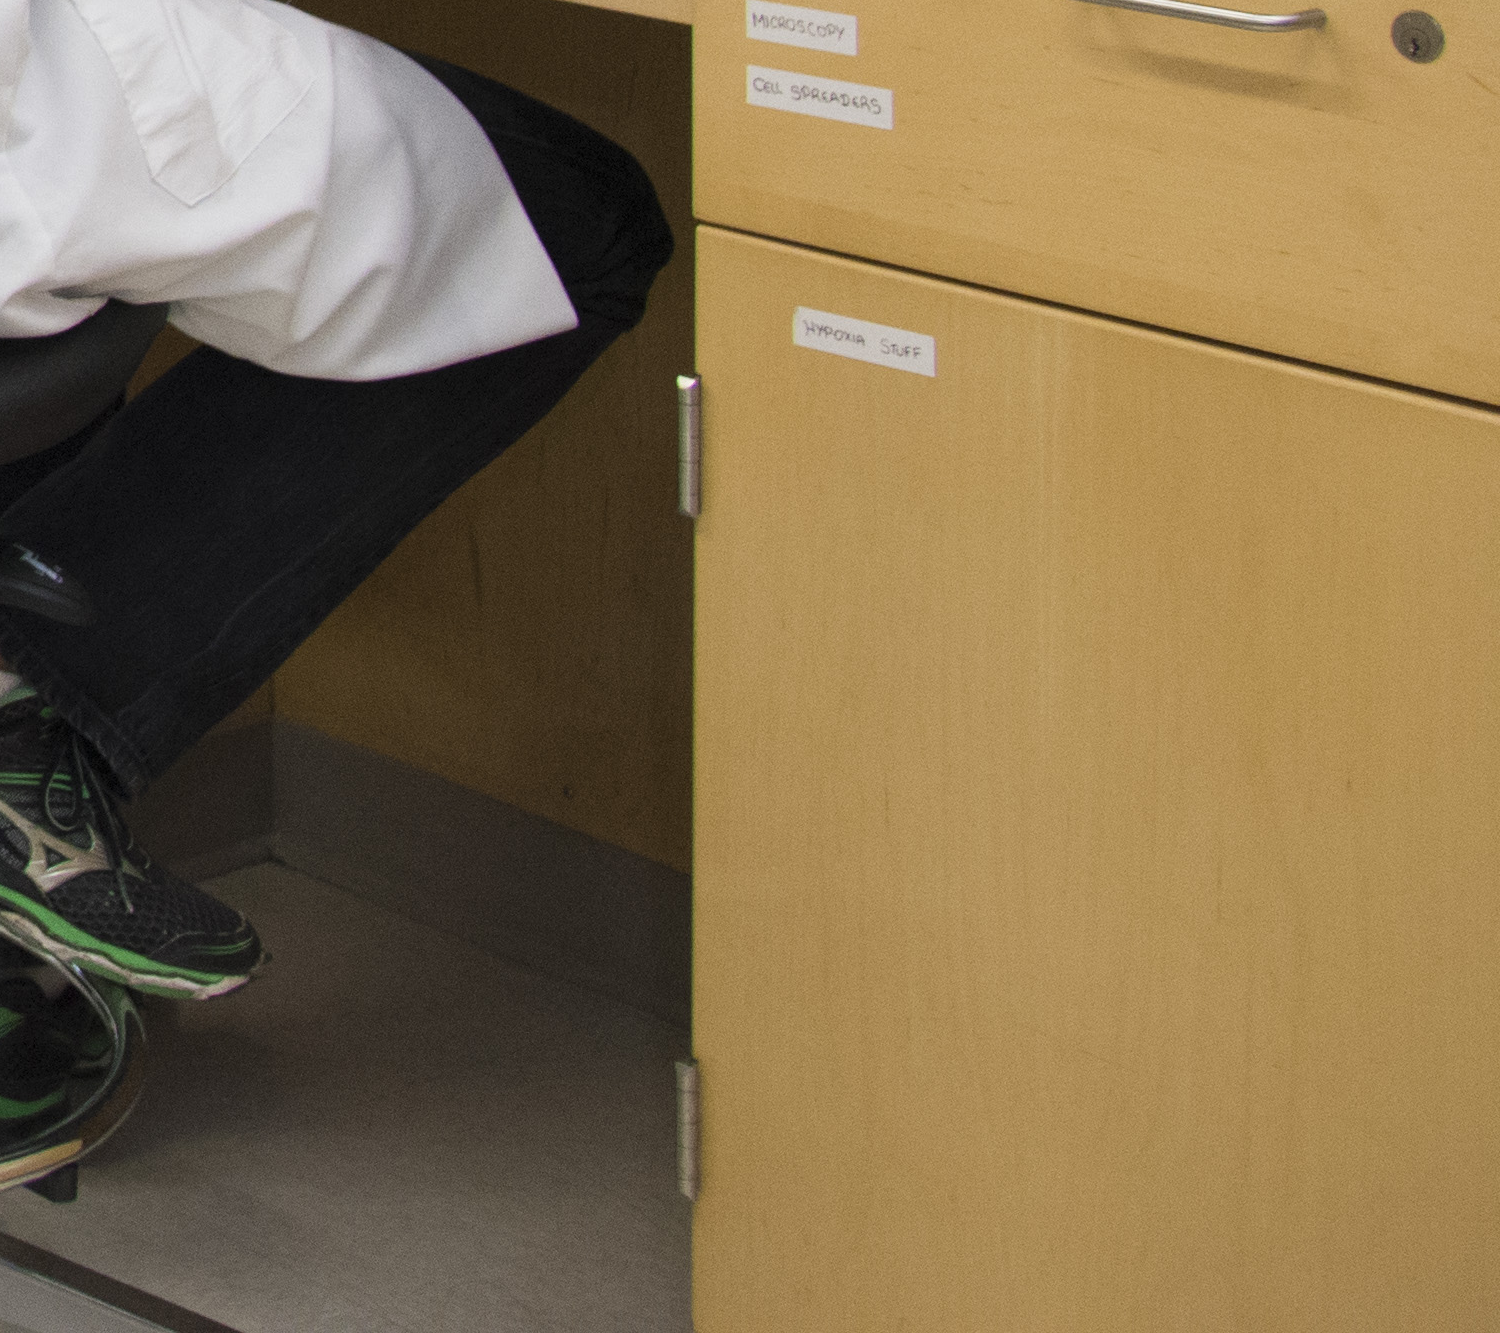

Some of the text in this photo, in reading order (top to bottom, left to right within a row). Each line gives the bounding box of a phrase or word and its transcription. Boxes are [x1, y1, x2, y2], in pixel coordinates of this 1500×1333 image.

[752, 12, 846, 41] MICROSCOPY
[753, 76, 882, 115] CELL SPREADERS
[802, 319, 922, 359] HYPOXIA STUFF
